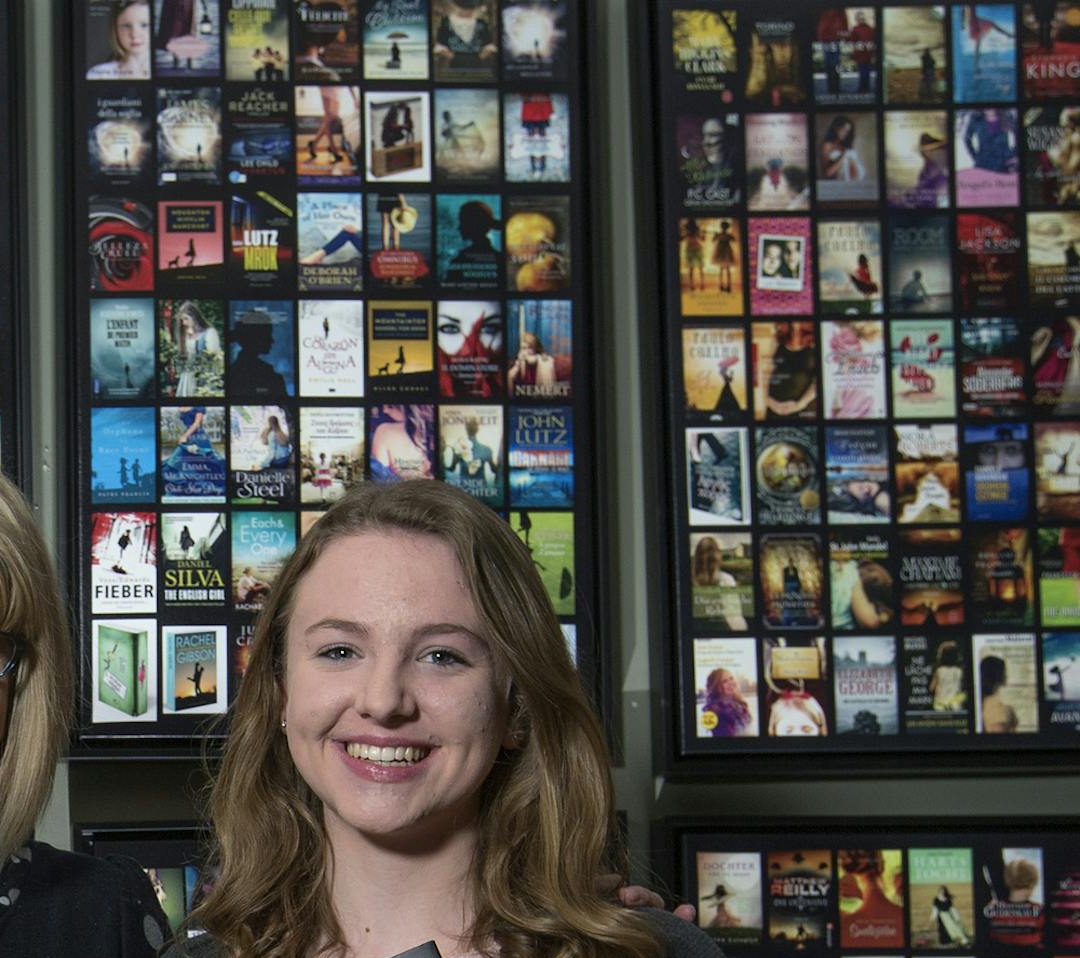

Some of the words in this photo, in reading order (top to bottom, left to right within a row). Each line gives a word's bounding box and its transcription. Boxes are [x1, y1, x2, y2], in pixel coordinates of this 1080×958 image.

[1026, 63, 1080, 79] KING
[241, 92, 275, 102] JACK
[229, 101, 288, 111] REACHER
[244, 229, 279, 246] LUTZ
[518, 415, 564, 430] JOHN
[516, 430, 567, 444] LUTZ
[235, 471, 291, 484] Danielle
[236, 482, 285, 499] Steel
[240, 526, 287, 545] Every
[176, 560, 212, 568] DANIEL
[165, 569, 225, 588] SILVA
[95, 585, 154, 599] FIEBER
[165, 590, 176, 600] THE
[178, 590, 207, 600] ENGLISH
[209, 590, 225, 600] GIRL
[176, 634, 216, 649] RACHEL
[176, 648, 216, 664] GIBSON
[770, 885, 830, 896] REILLY
